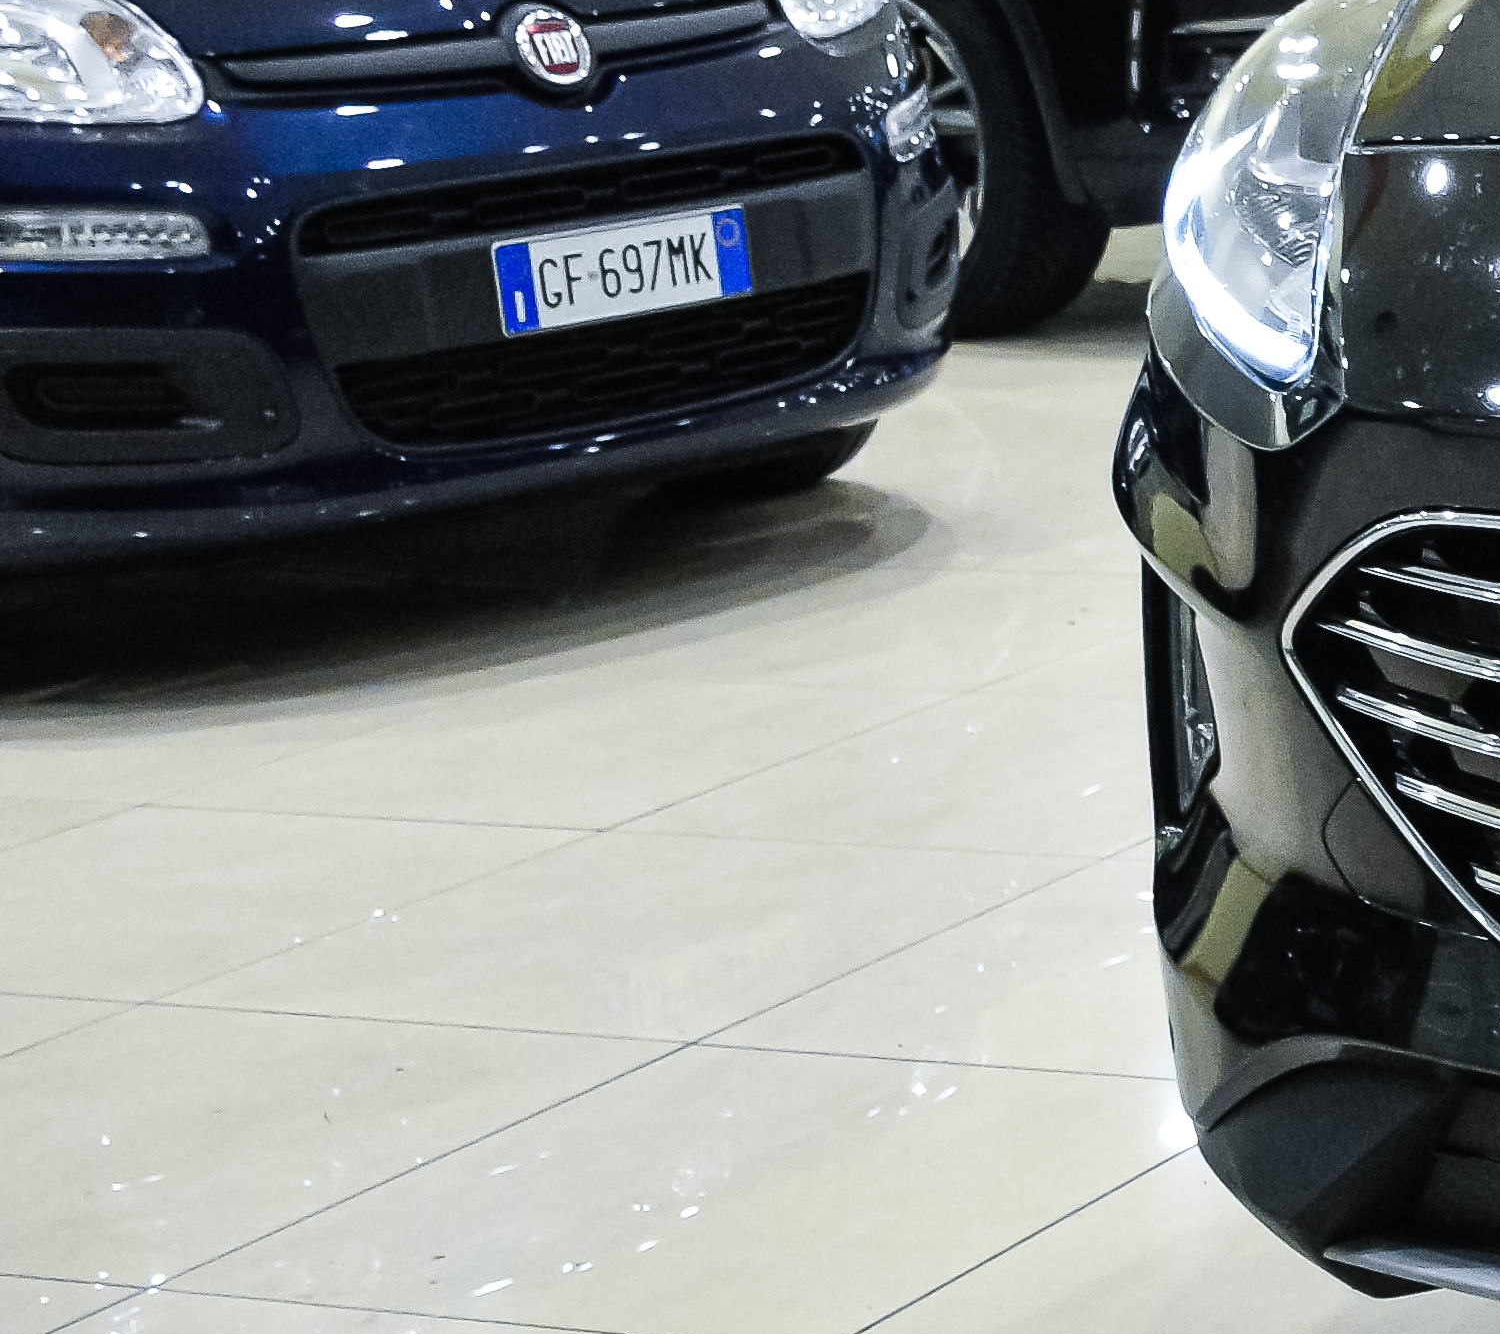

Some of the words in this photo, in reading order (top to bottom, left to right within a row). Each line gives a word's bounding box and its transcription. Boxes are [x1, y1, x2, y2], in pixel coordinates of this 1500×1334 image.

[532, 31, 579, 66] FIAT
[538, 251, 583, 309] GF
[599, 232, 715, 298] 697MK
